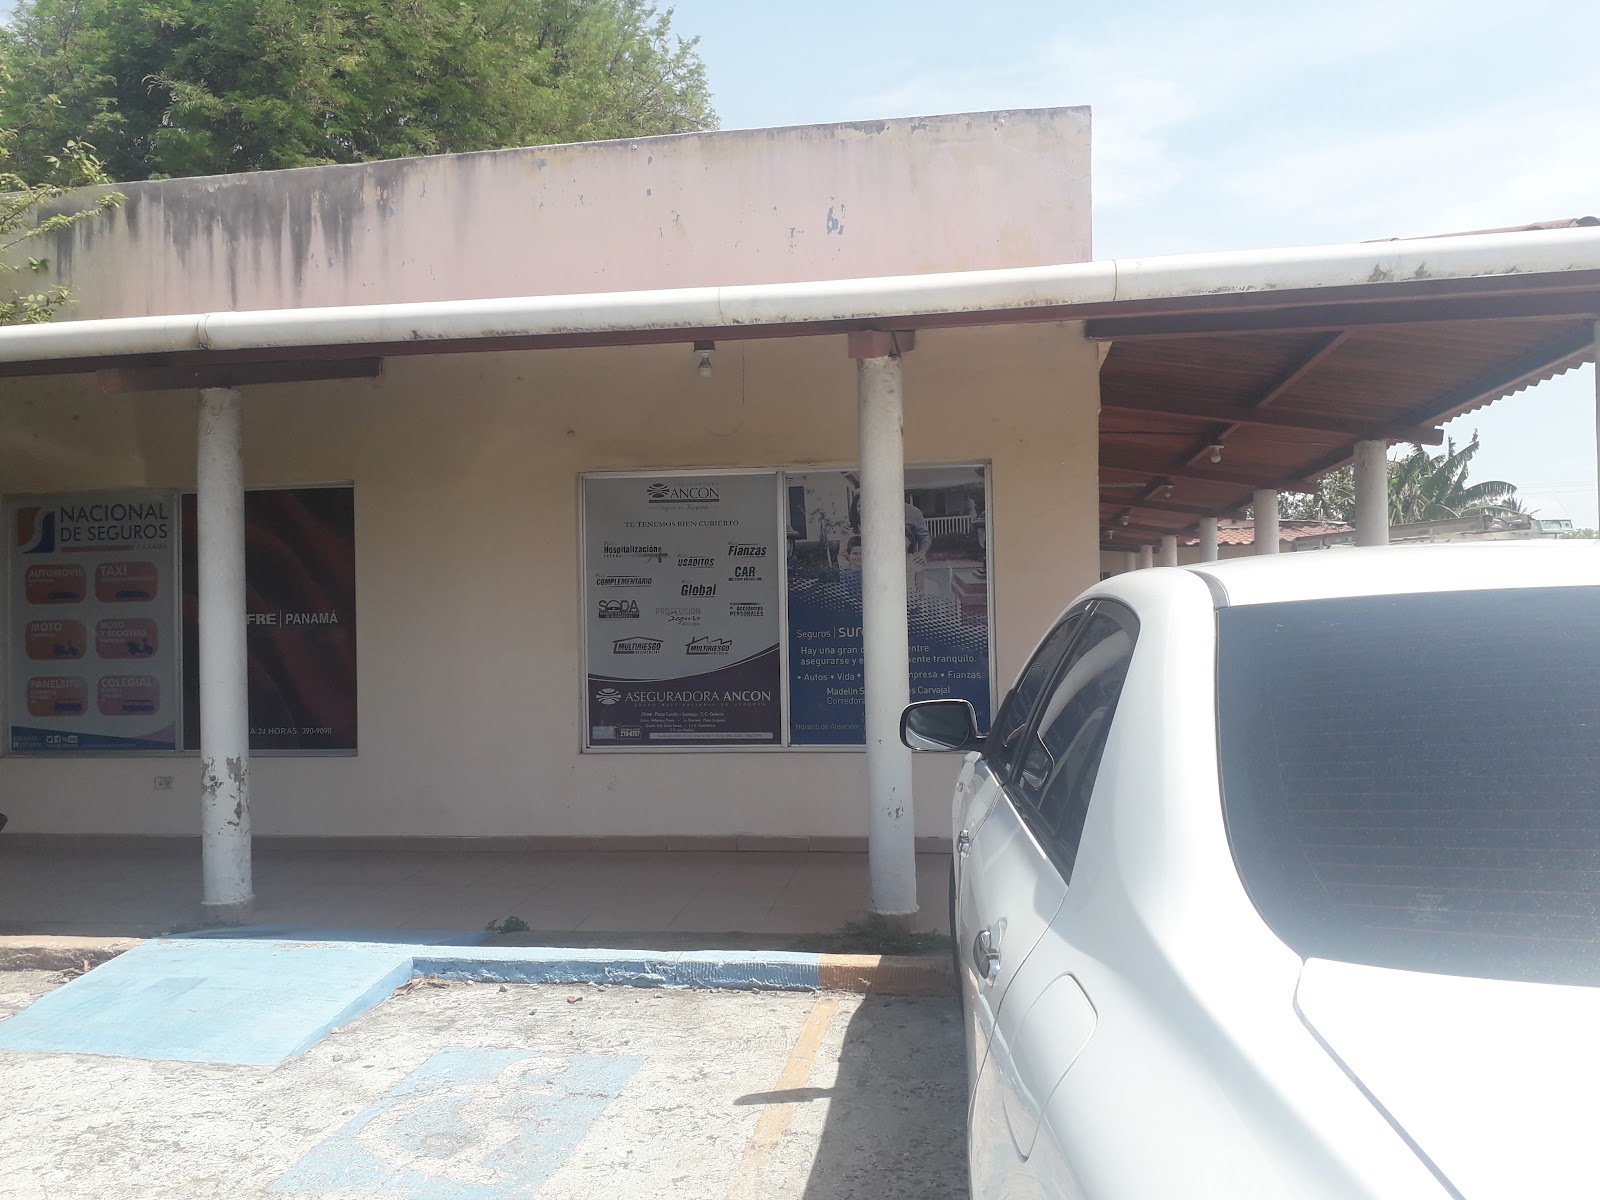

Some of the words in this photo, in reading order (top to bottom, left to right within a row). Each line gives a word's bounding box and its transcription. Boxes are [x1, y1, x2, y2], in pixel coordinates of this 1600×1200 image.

[670, 487, 719, 499] ANCON
[60, 503, 169, 523] NACIONAL
[60, 526, 82, 542] DE
[87, 524, 168, 541] SEGUROS
[603, 544, 658, 554] Hospitalización
[728, 545, 767, 556] Fianzas
[677, 558, 715, 567] USADITOS
[101, 566, 127, 576] TAXI
[734, 566, 756, 577] CAR
[596, 577, 652, 586] COMPLEMENTARIO
[680, 584, 717, 597] Global
[598, 599, 640, 612] SODA
[246, 613, 277, 625] FRE
[285, 609, 338, 625] PANAMÁ
[31, 622, 62, 632] MOTO
[796, 629, 831, 640] Seguros
[838, 627, 863, 638] sur
[617, 642, 662, 651] MULTIRIESGO
[690, 644, 730, 652] MULTIRIESGO
[801, 646, 817, 656] Hay
[837, 647, 858, 655] gran
[800, 657, 850, 666] asegurarse
[851, 657, 857, 665] y
[933, 654, 977, 664] tranquilo.
[804, 673, 828, 681] Autos
[947, 670, 982, 679] Fianzas
[101, 678, 153, 688] COLEGIAL
[625, 690, 719, 702] ASEGURADORA
[723, 690, 771, 701] ANCON
[826, 687, 858, 695] Madelin
[918, 686, 951, 696] Carvajal
[301, 727, 332, 735] 390-9090
